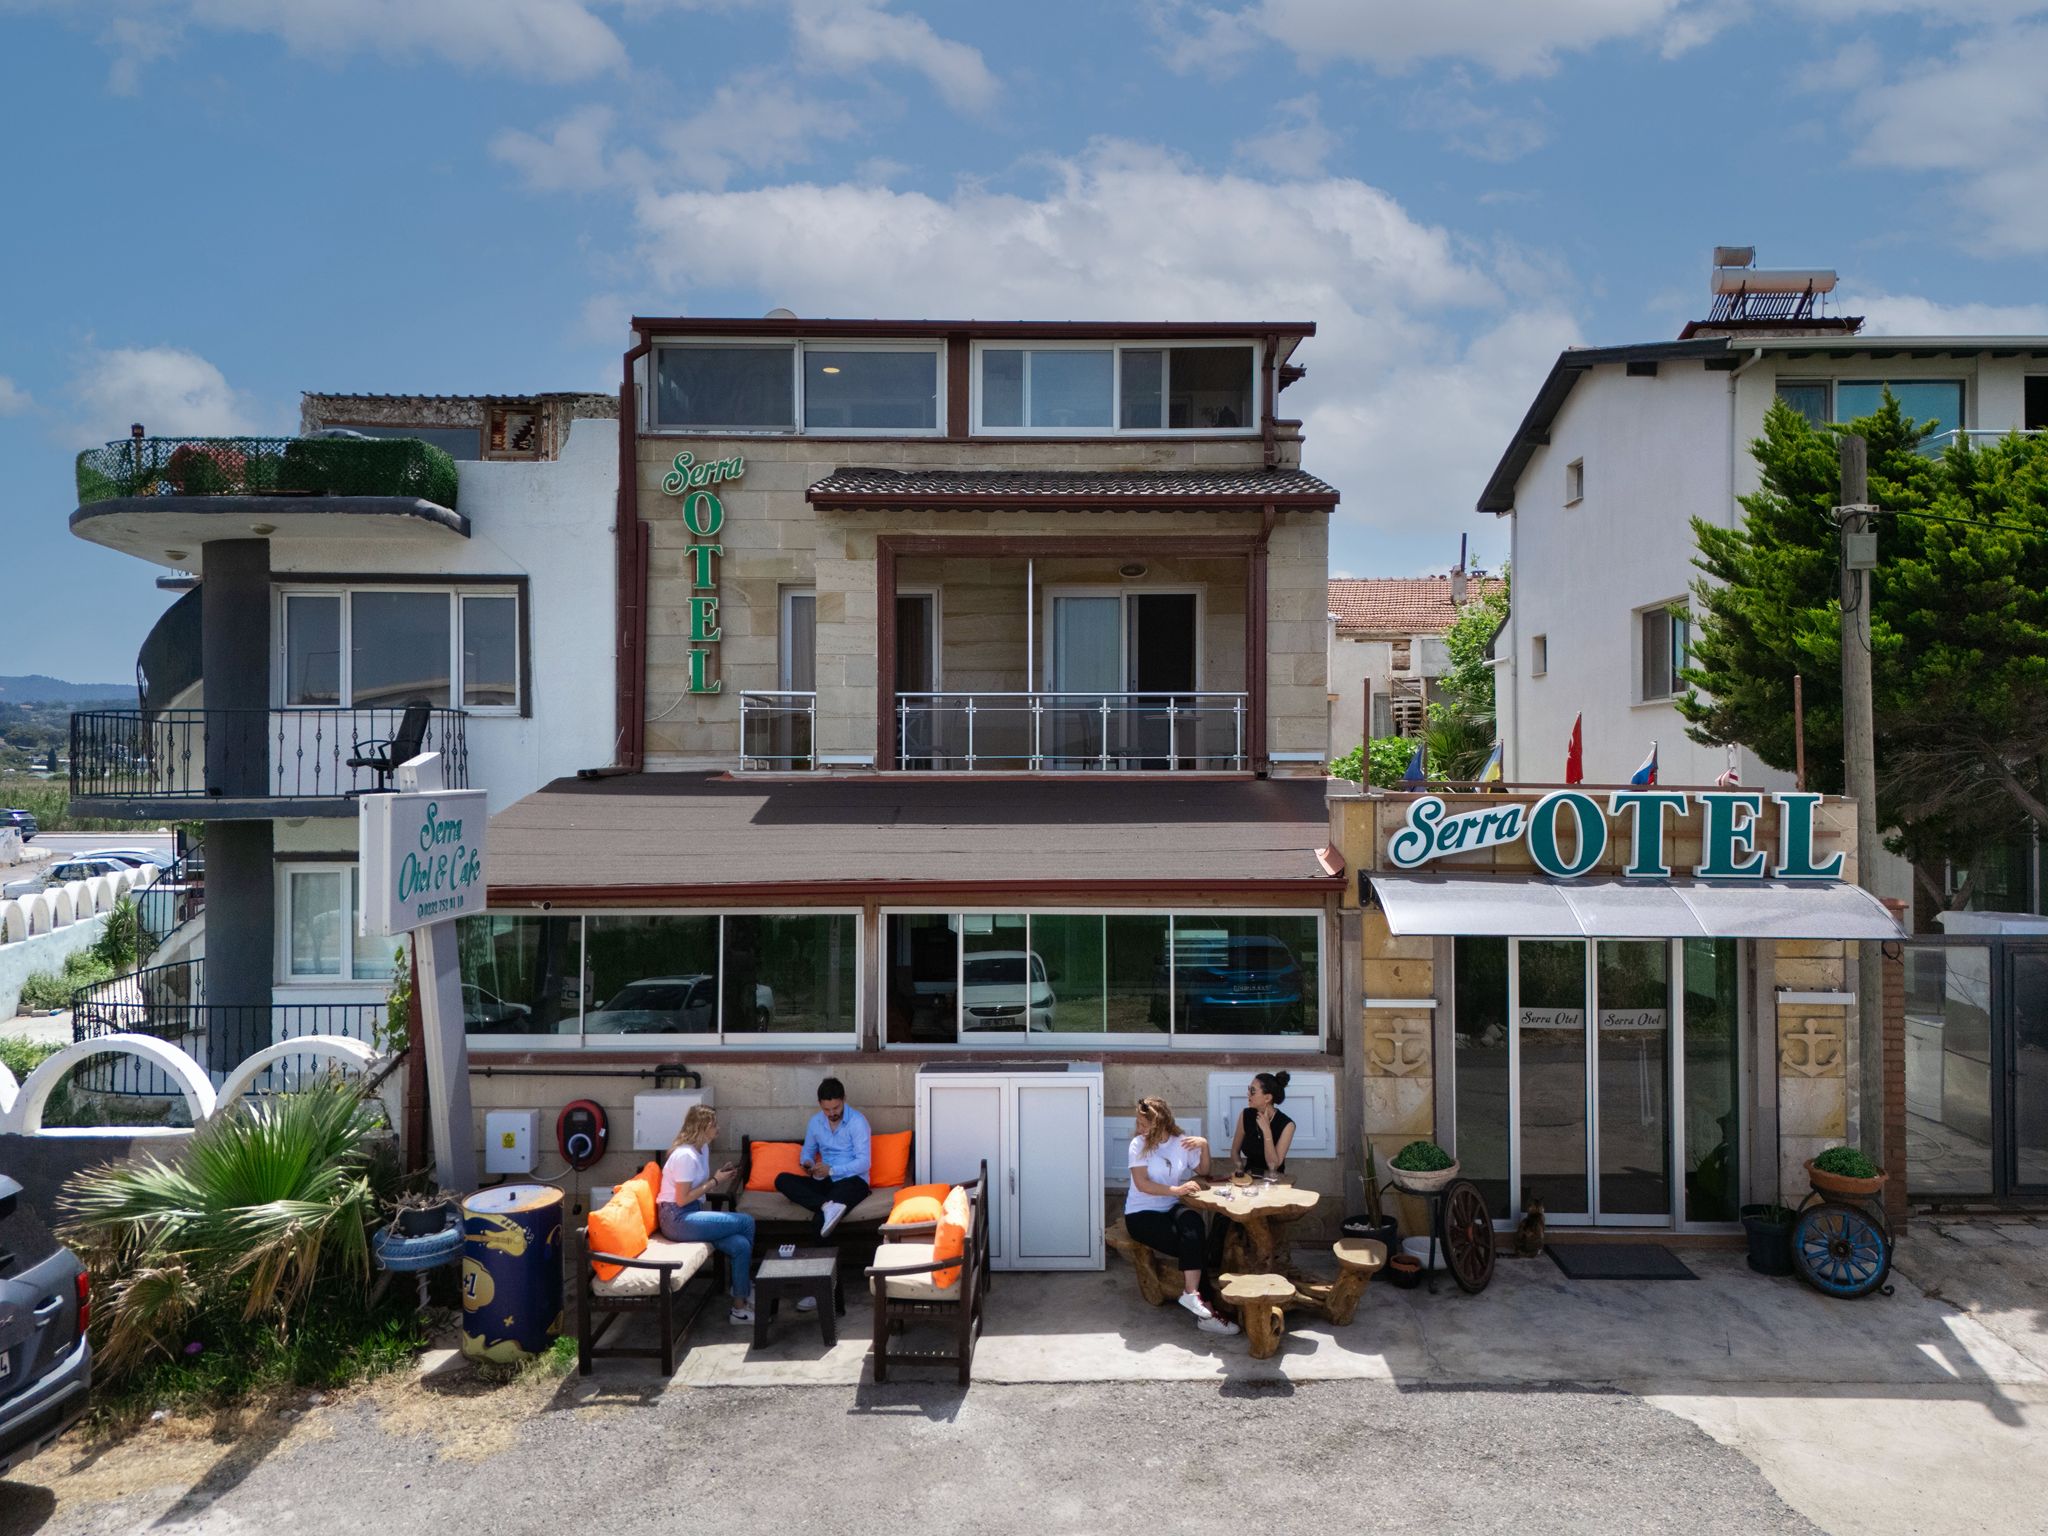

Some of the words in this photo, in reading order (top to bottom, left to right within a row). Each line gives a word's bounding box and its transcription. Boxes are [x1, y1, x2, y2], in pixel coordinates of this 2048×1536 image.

[661, 451, 745, 496] Serra
[682, 490, 725, 694] OTEL
[420, 802, 463, 851] Serra
[1389, 797, 1525, 867] Serra
[1527, 790, 1846, 879] OTEL
[399, 852, 434, 902] Otel
[435, 854, 448, 890] &
[450, 845, 481, 890] Cafe
[1521, 1011, 1551, 1025] Serra
[1554, 1012, 1579, 1025] Otel
[1604, 1013, 1633, 1027] Serra
[1637, 1012, 1662, 1026] Otel
